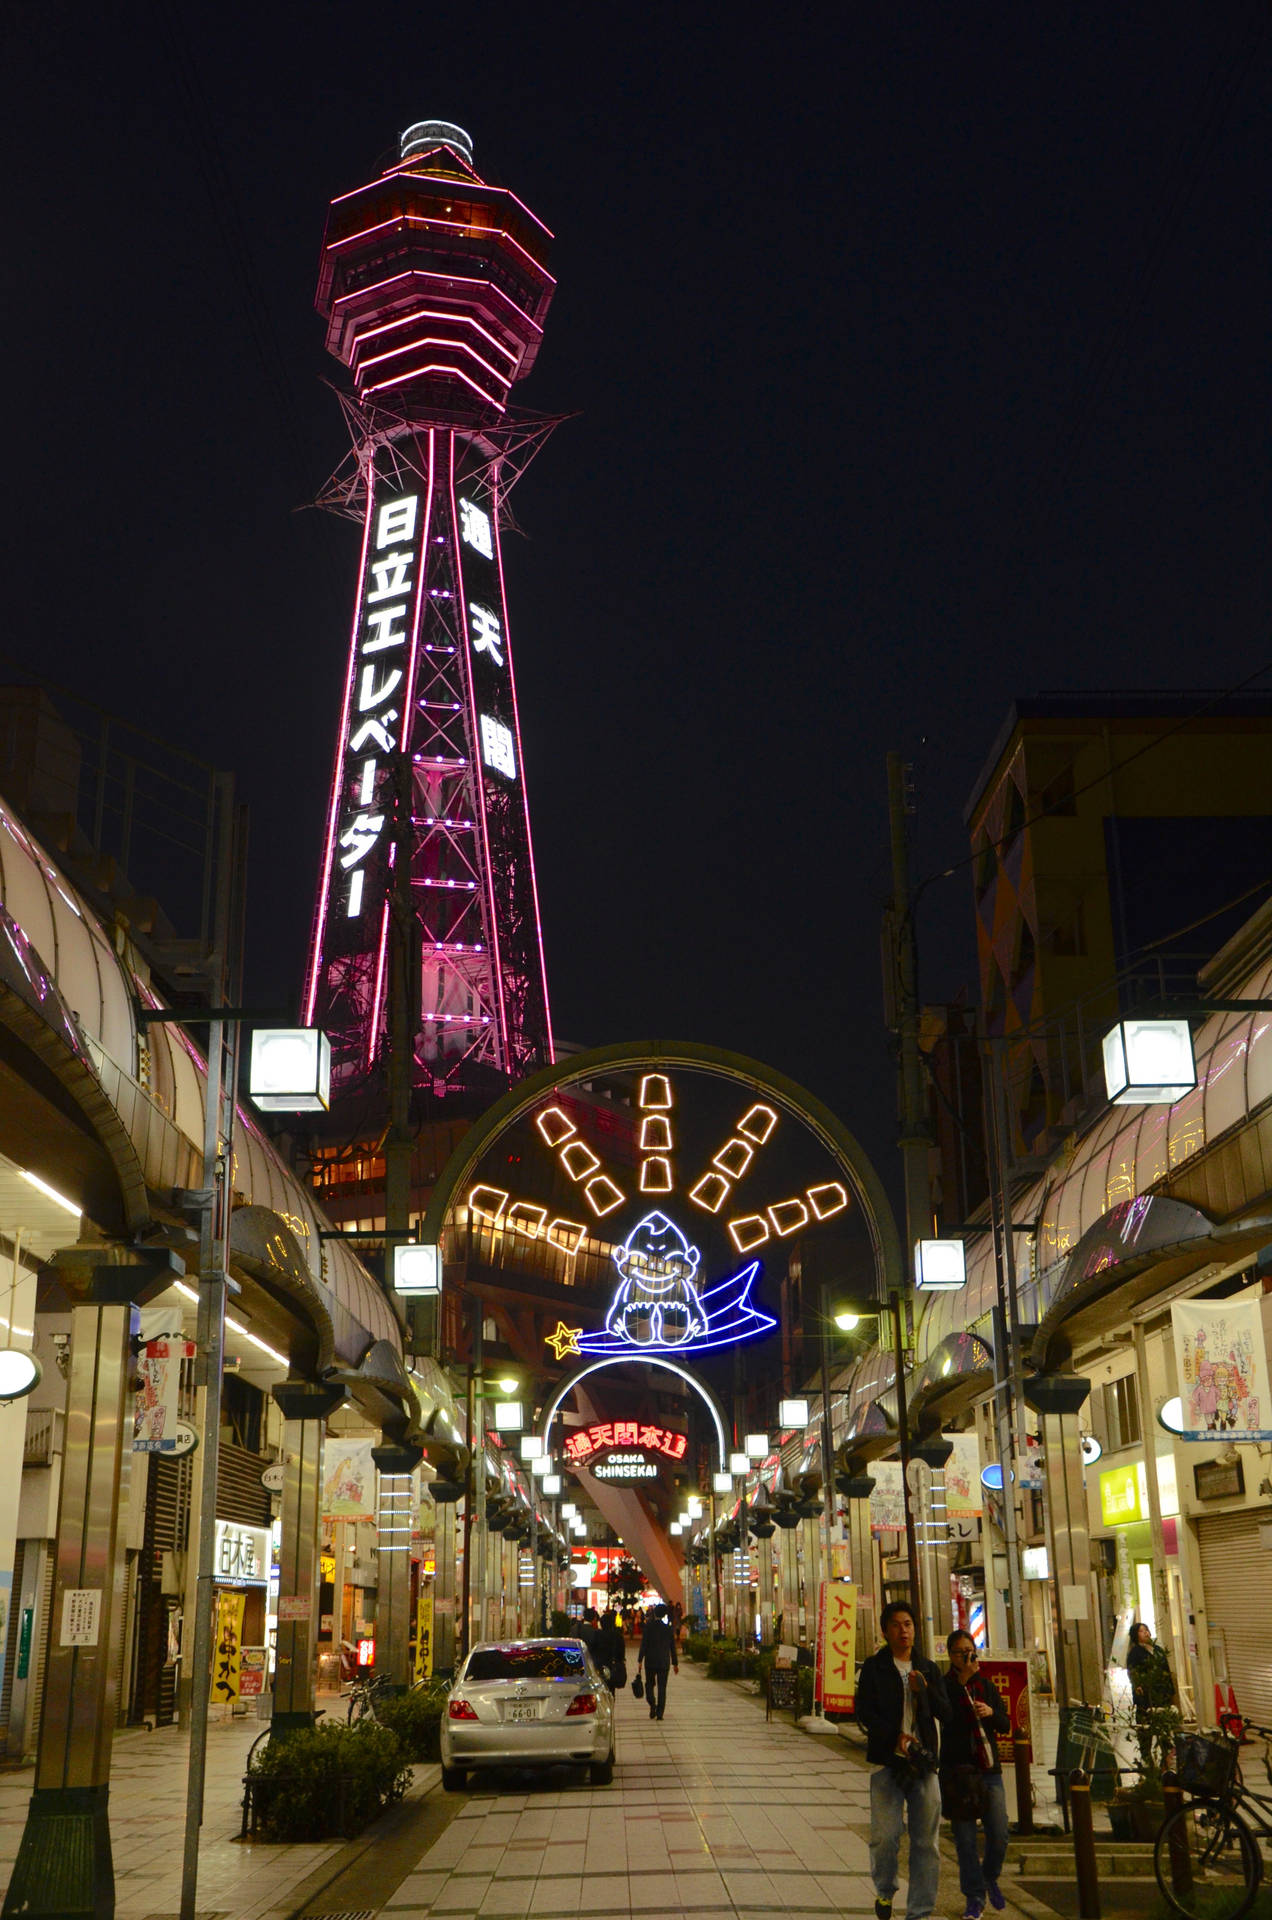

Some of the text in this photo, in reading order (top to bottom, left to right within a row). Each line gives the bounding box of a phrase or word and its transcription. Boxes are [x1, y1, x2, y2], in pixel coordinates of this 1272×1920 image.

[459, 497, 517, 780] 通天閣
[339, 495, 418, 918] 日立エレベーター
[565, 1422, 688, 1459] 通天閣本通
[607, 1454, 645, 1464] OSAKA
[594, 1465, 658, 1478] SHINSEKAI
[219, 1523, 255, 1577] 白木屋
